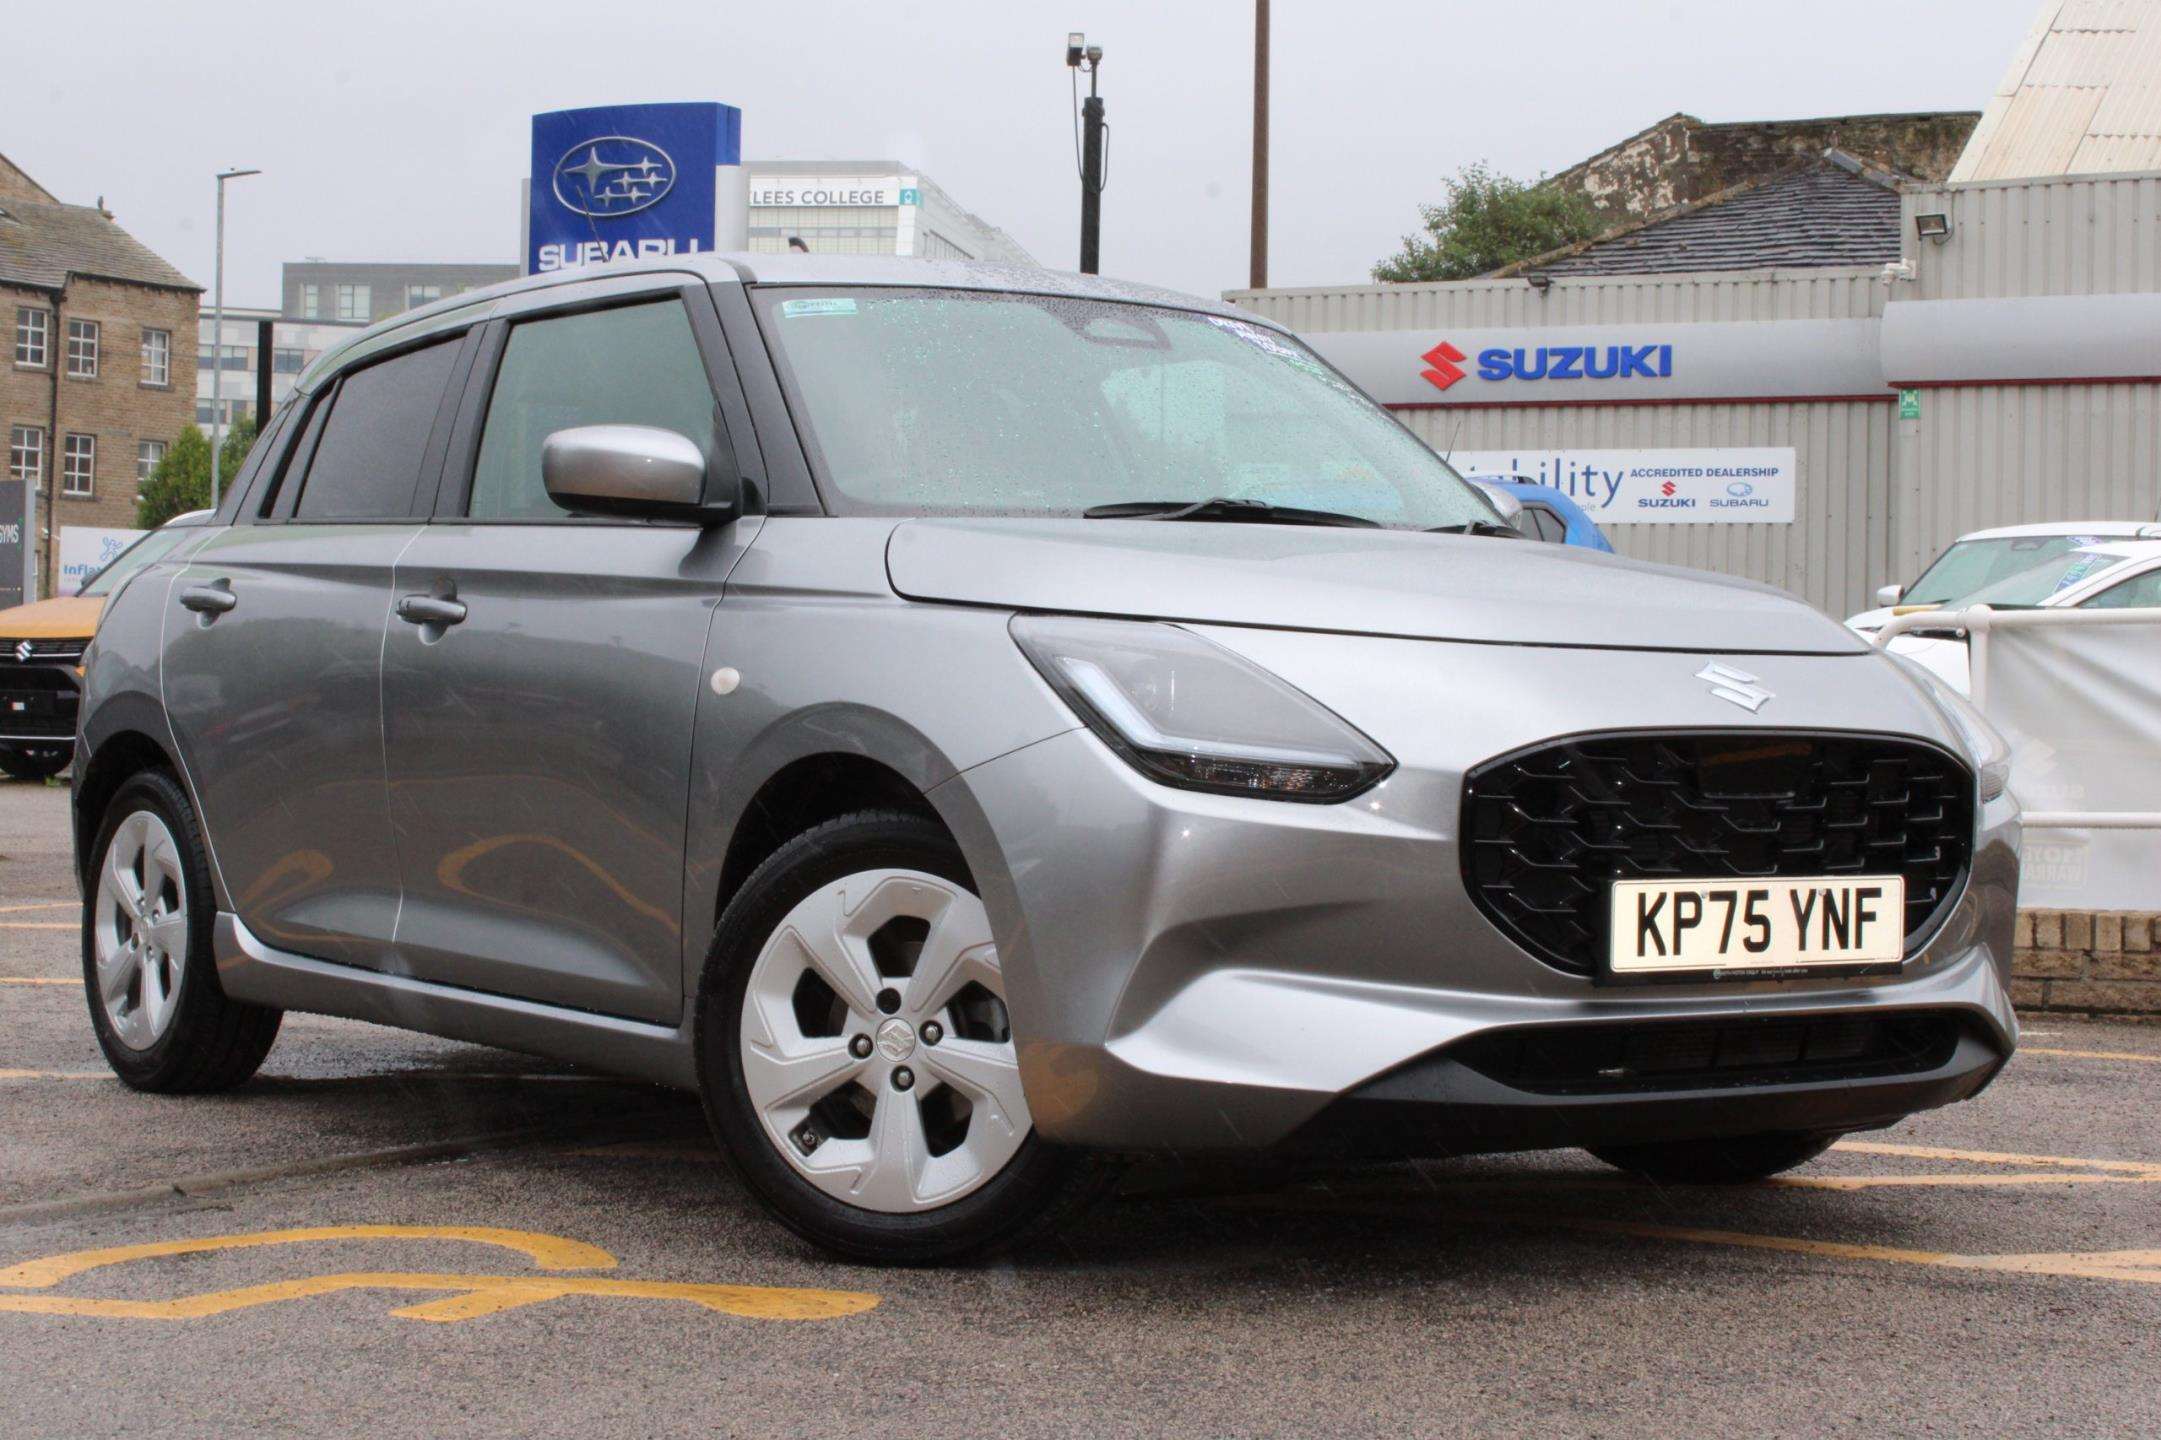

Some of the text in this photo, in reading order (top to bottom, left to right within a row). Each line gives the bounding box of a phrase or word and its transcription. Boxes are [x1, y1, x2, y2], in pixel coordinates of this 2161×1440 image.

[752, 190, 884, 205] LEES COLLEGE
[538, 238, 698, 272] SUBARU
[1478, 345, 1672, 381] SUZUKI
[1630, 467, 1779, 478] ACCREDITED DEALERSHIP
[1638, 498, 1769, 508] SUZUKI SUBARU
[1636, 887, 1882, 957] KP75 YNF
